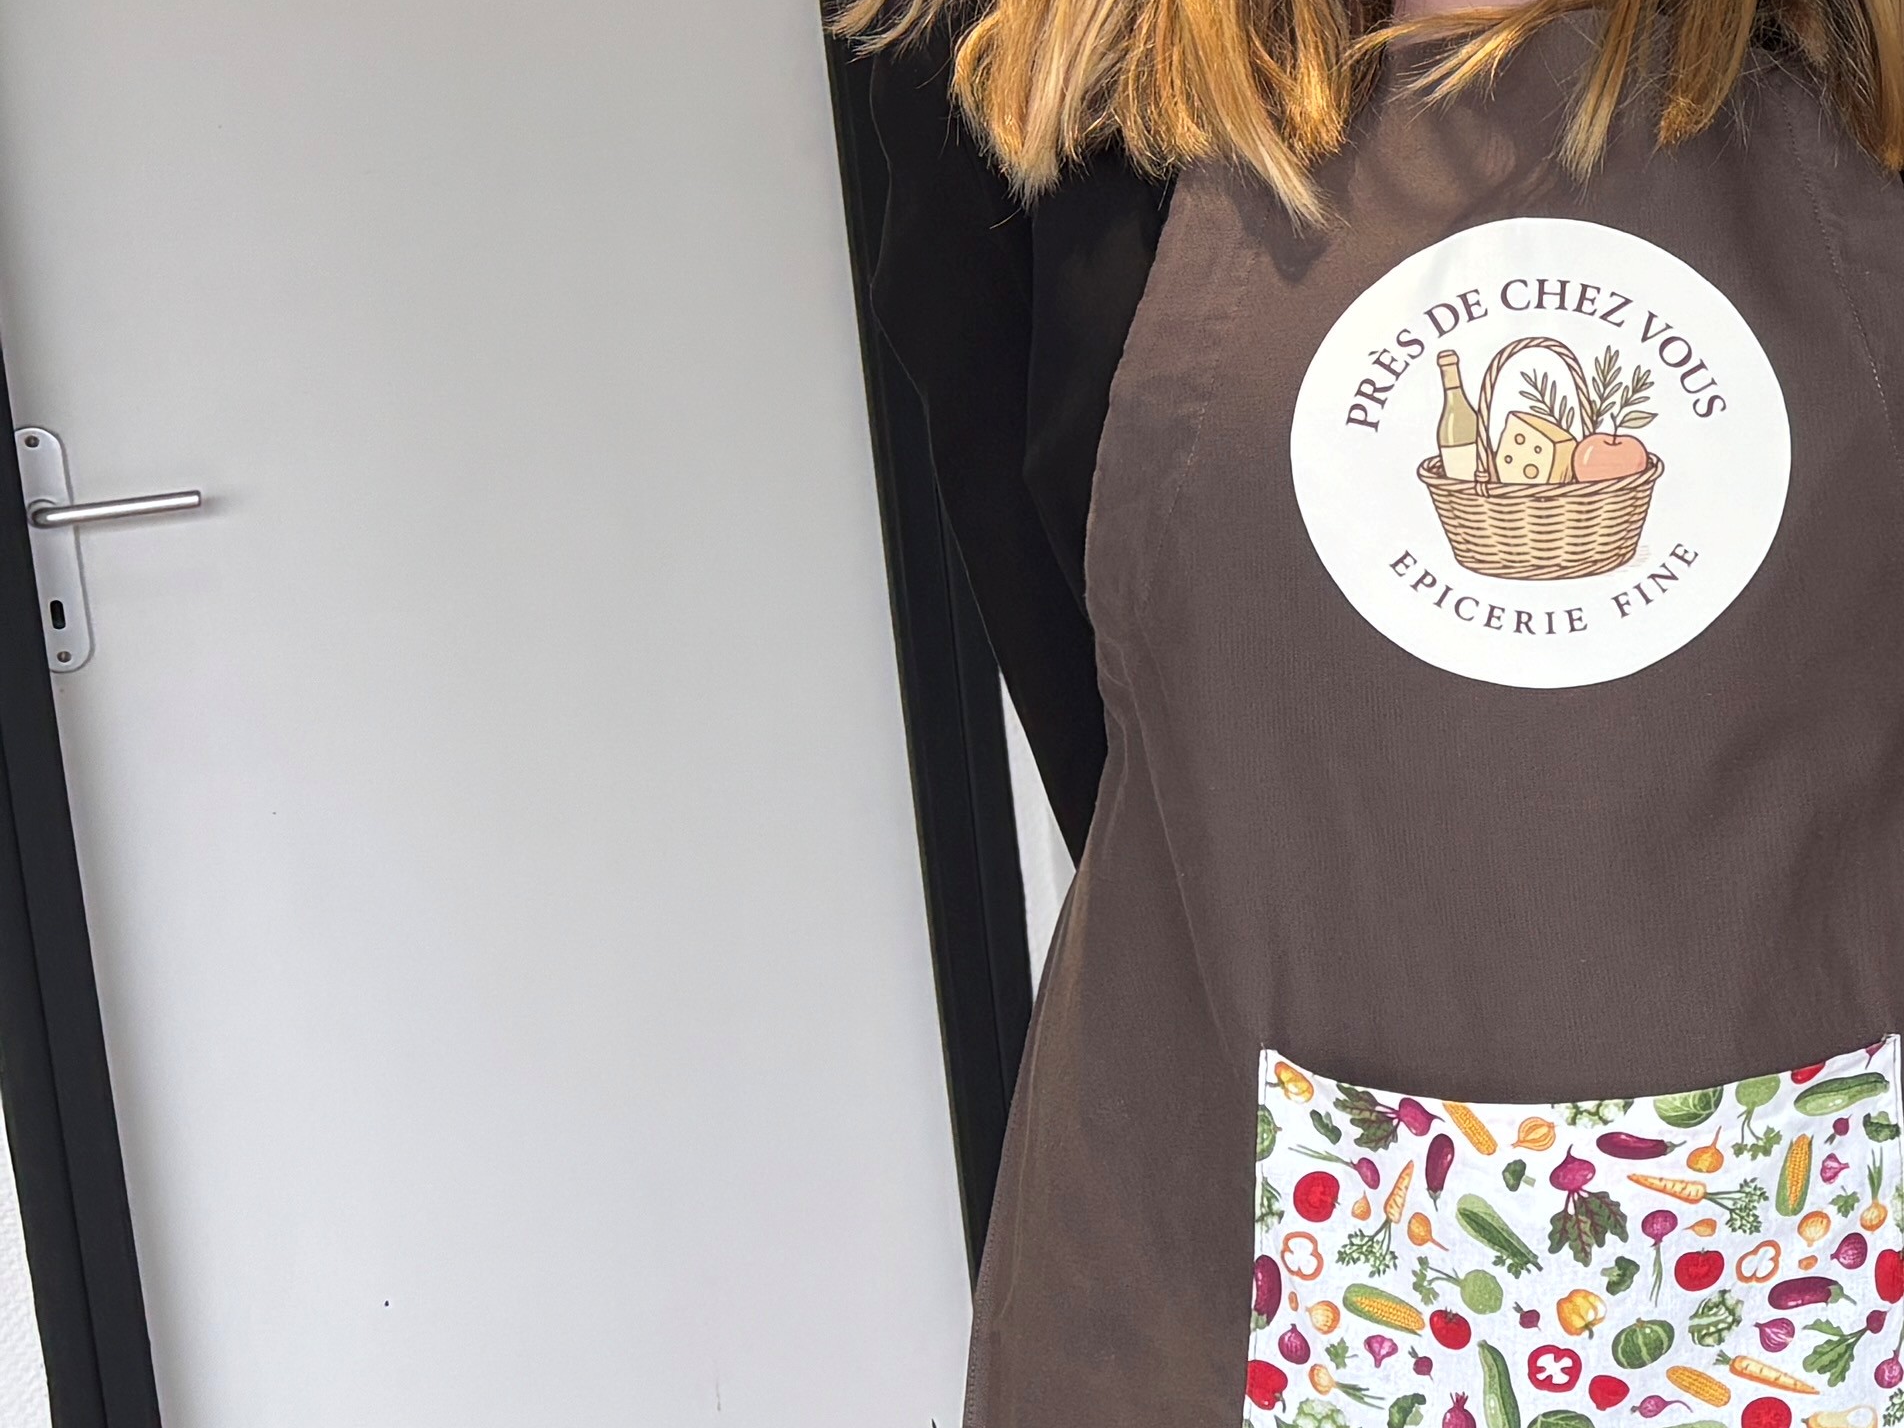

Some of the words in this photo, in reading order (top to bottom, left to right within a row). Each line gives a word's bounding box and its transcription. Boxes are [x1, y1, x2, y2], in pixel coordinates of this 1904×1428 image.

[1346, 328, 1425, 432] PRÈS
[1424, 288, 1489, 339] DE
[1500, 278, 1634, 328] CHEZ
[1638, 310, 1728, 419] VOUS
[1388, 549, 1588, 635] EPICERIE
[1611, 541, 1700, 619] FINE
